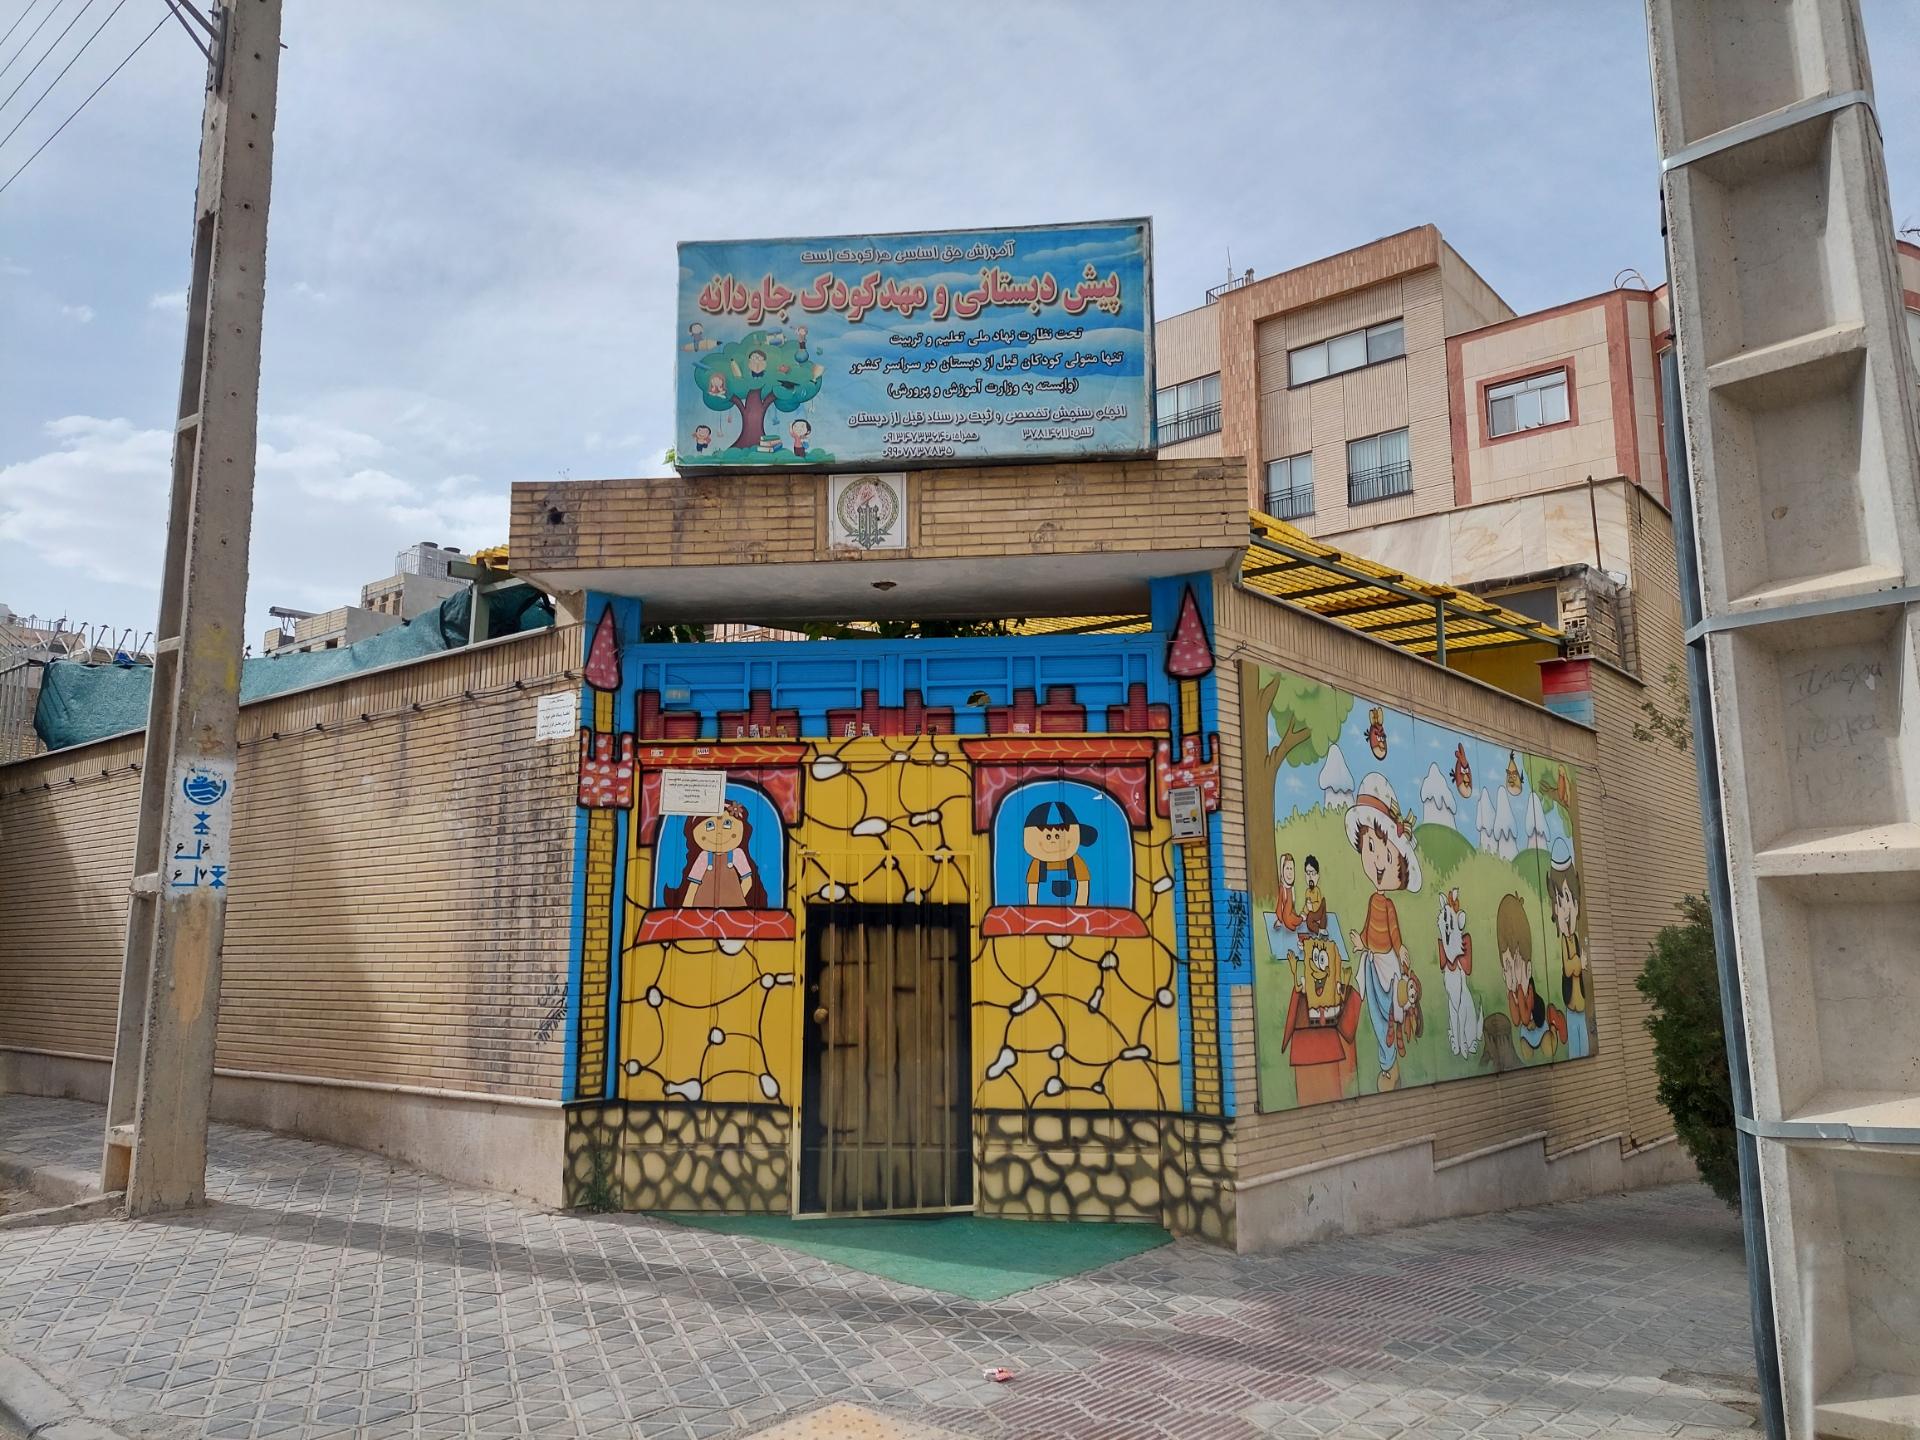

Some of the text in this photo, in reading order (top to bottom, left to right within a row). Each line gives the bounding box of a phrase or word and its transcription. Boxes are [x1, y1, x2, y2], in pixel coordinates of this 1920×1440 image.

[800, 248, 834, 263] است
[894, 246, 939, 263] اساسی
[942, 246, 963, 262] حق
[965, 240, 1014, 261] آموزش
[953, 266, 1058, 317] دبستانی
[1062, 263, 1120, 314] پیش
[698, 272, 794, 323] جاودانه
[931, 284, 948, 318] و
[890, 328, 1083, 347] تحت نظارت نهاد ملی تعلیم و تربیت
[850, 350, 1124, 374] تنها متولی کودکان قبل از دبستان در سراسر کشور
[887, 379, 1080, 398] (وابسته به وزارت آموزش و پرورش)
[848, 411, 888, 427] دبستان
[890, 411, 900, 426] از
[902, 411, 924, 426] قبل
[954, 412, 966, 425] در
[968, 407, 993, 425] ثبت
[995, 411, 1003, 424] و
[1005, 407, 1050, 424] تخصصی
[1052, 406, 1092, 421] سنجش
[1094, 404, 1127, 420] انجام
[1070, 426, 1094, 438] تلفن:
